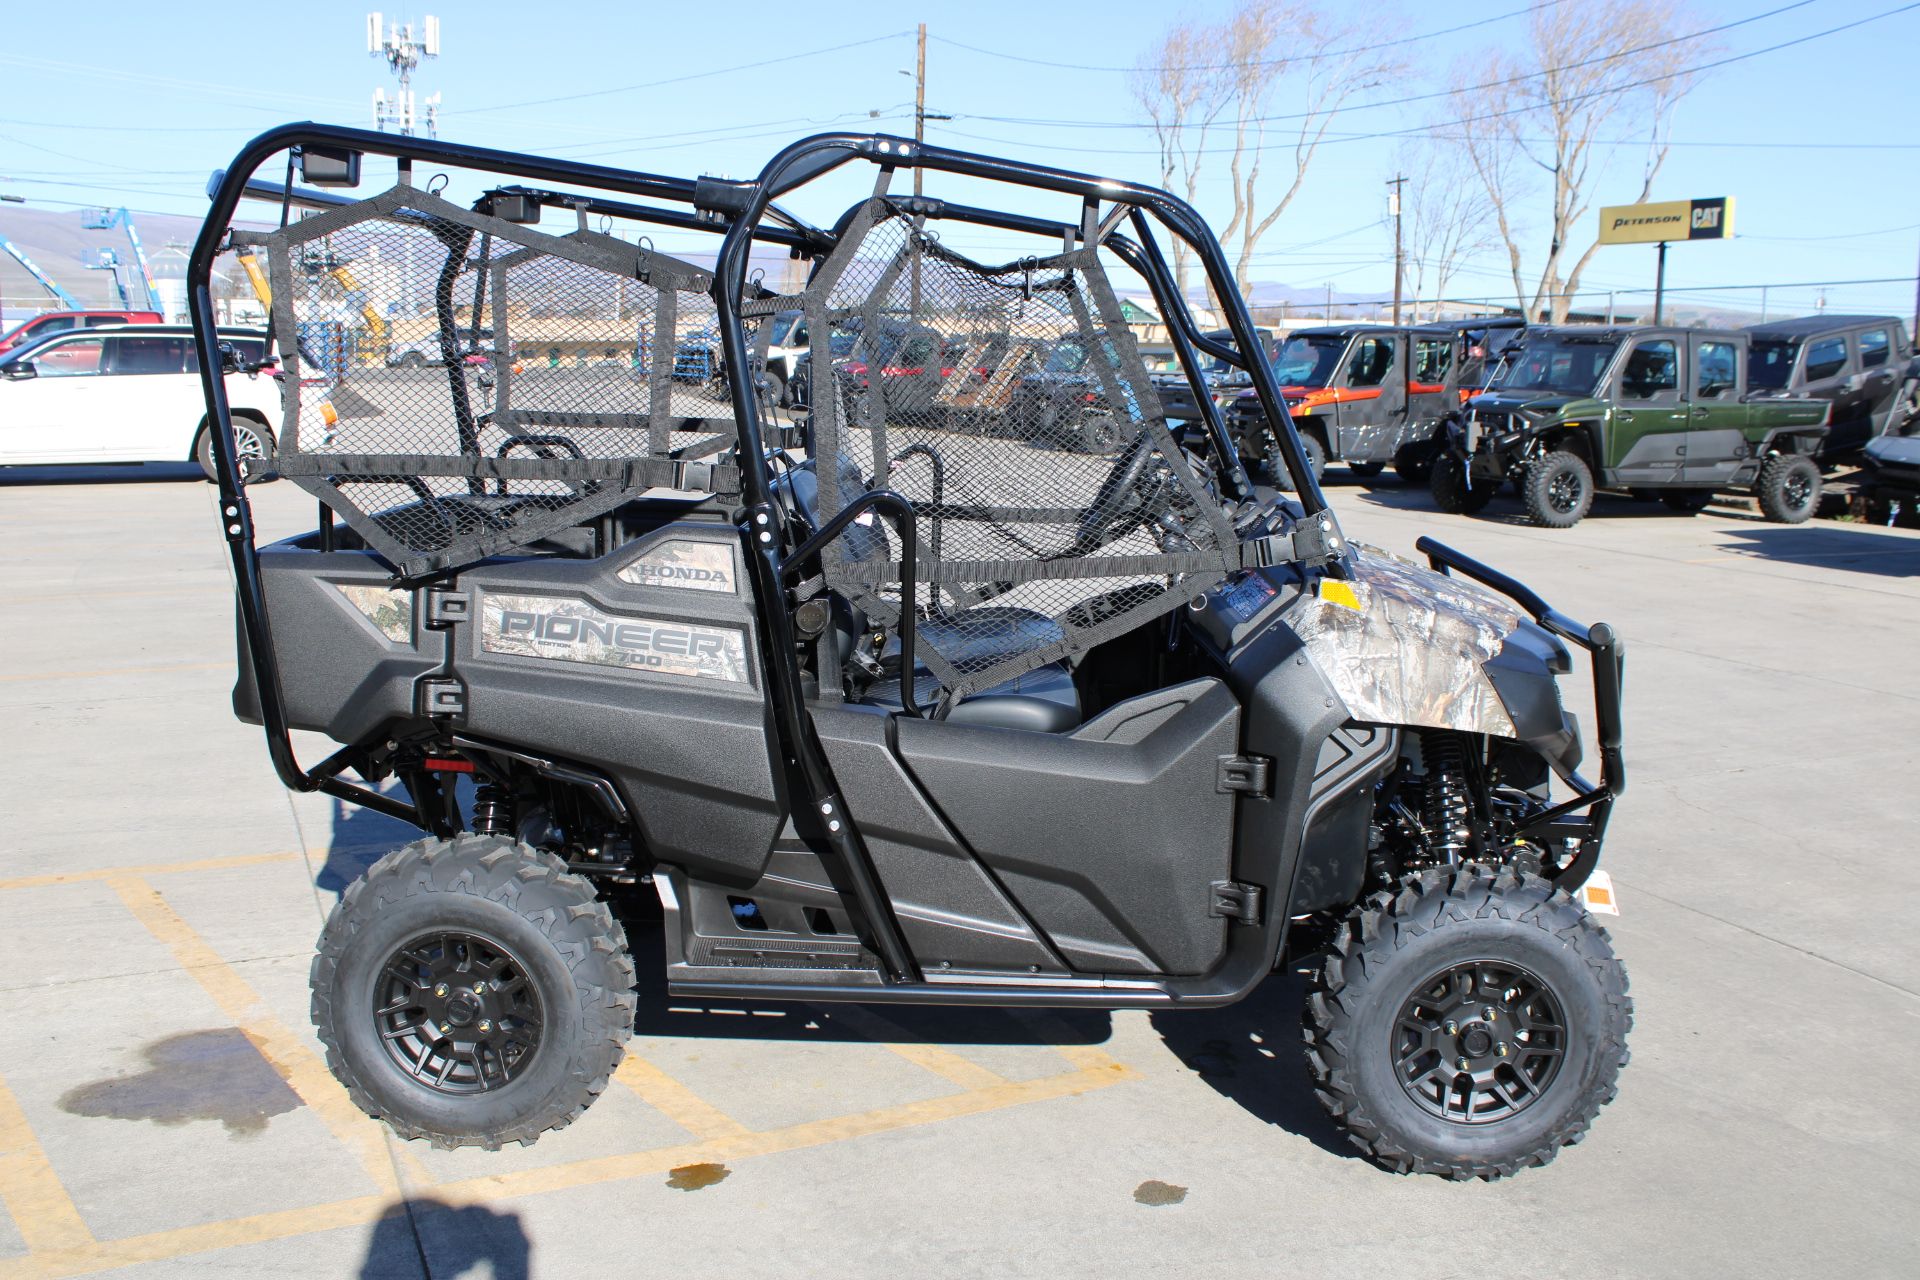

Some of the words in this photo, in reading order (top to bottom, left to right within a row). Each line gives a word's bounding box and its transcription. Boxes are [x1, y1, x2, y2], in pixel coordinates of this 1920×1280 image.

[1612, 215, 1682, 231] PETERSON
[1692, 207, 1721, 228] CAT
[639, 564, 728, 583] HONDA
[501, 610, 726, 659] PIONEER
[538, 640, 572, 649] EDITION
[614, 652, 662, 666] 700
